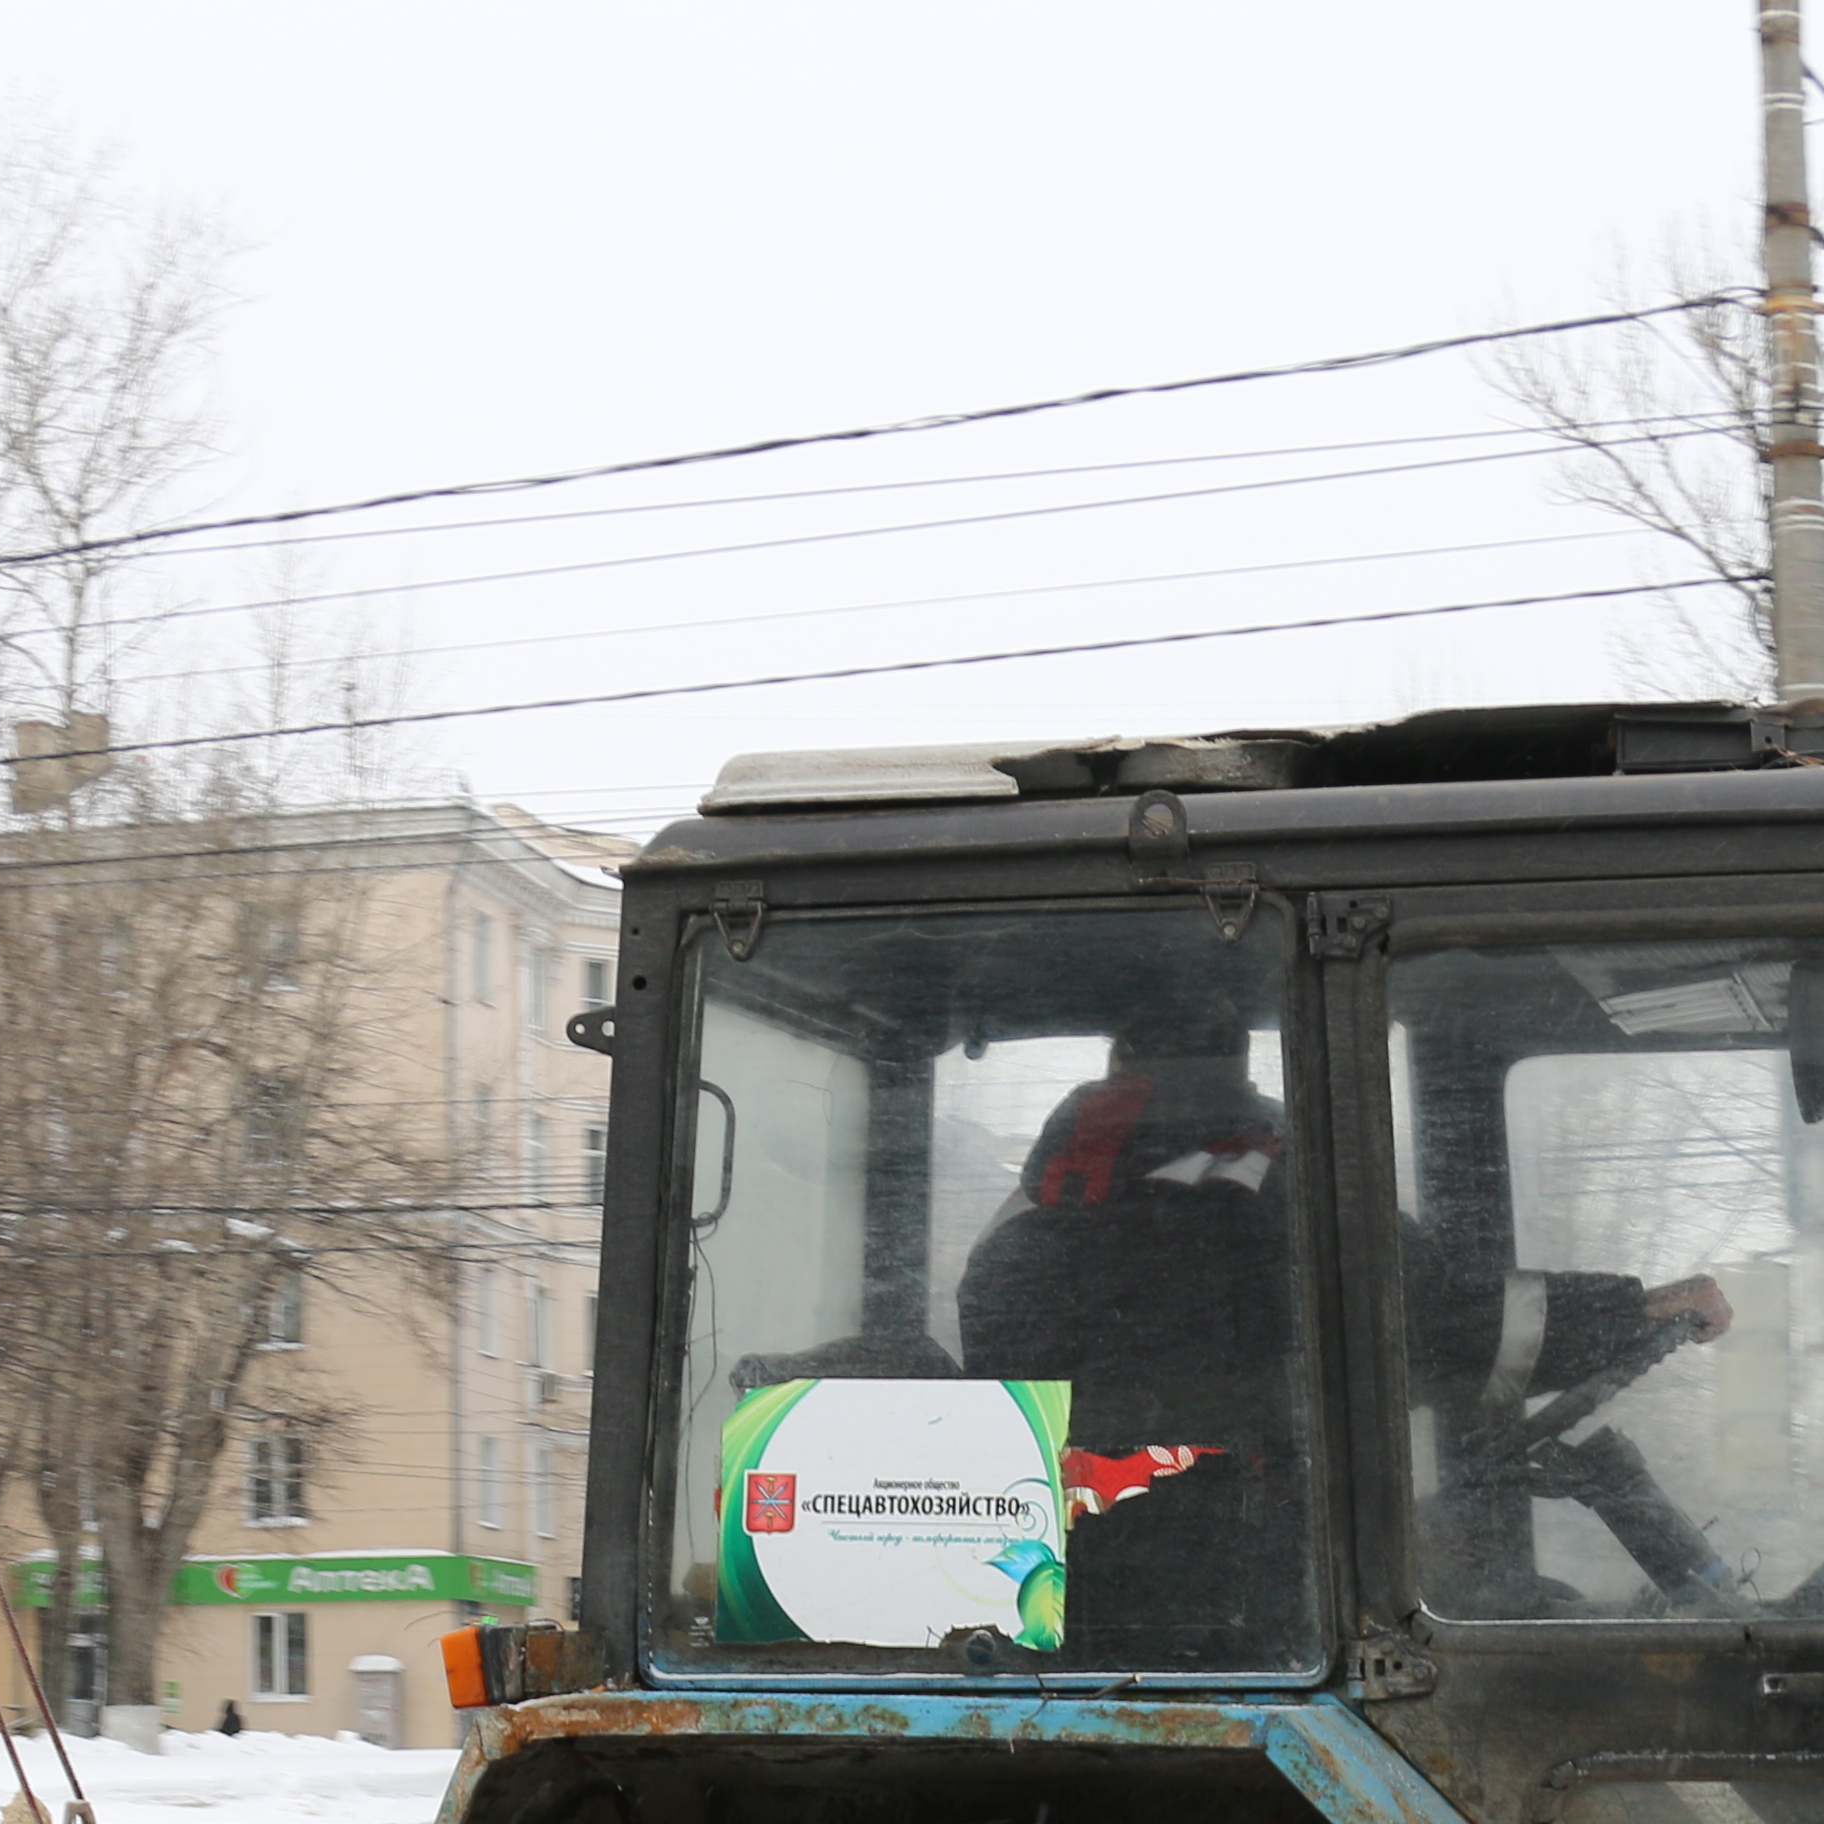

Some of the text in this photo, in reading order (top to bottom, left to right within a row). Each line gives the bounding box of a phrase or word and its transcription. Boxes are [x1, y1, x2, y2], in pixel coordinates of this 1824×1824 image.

[873, 1477, 961, 1491] Акционерное общество
[801, 1492, 1030, 1518] «СПЕЦАВТОХОЗЯЙСТВО»
